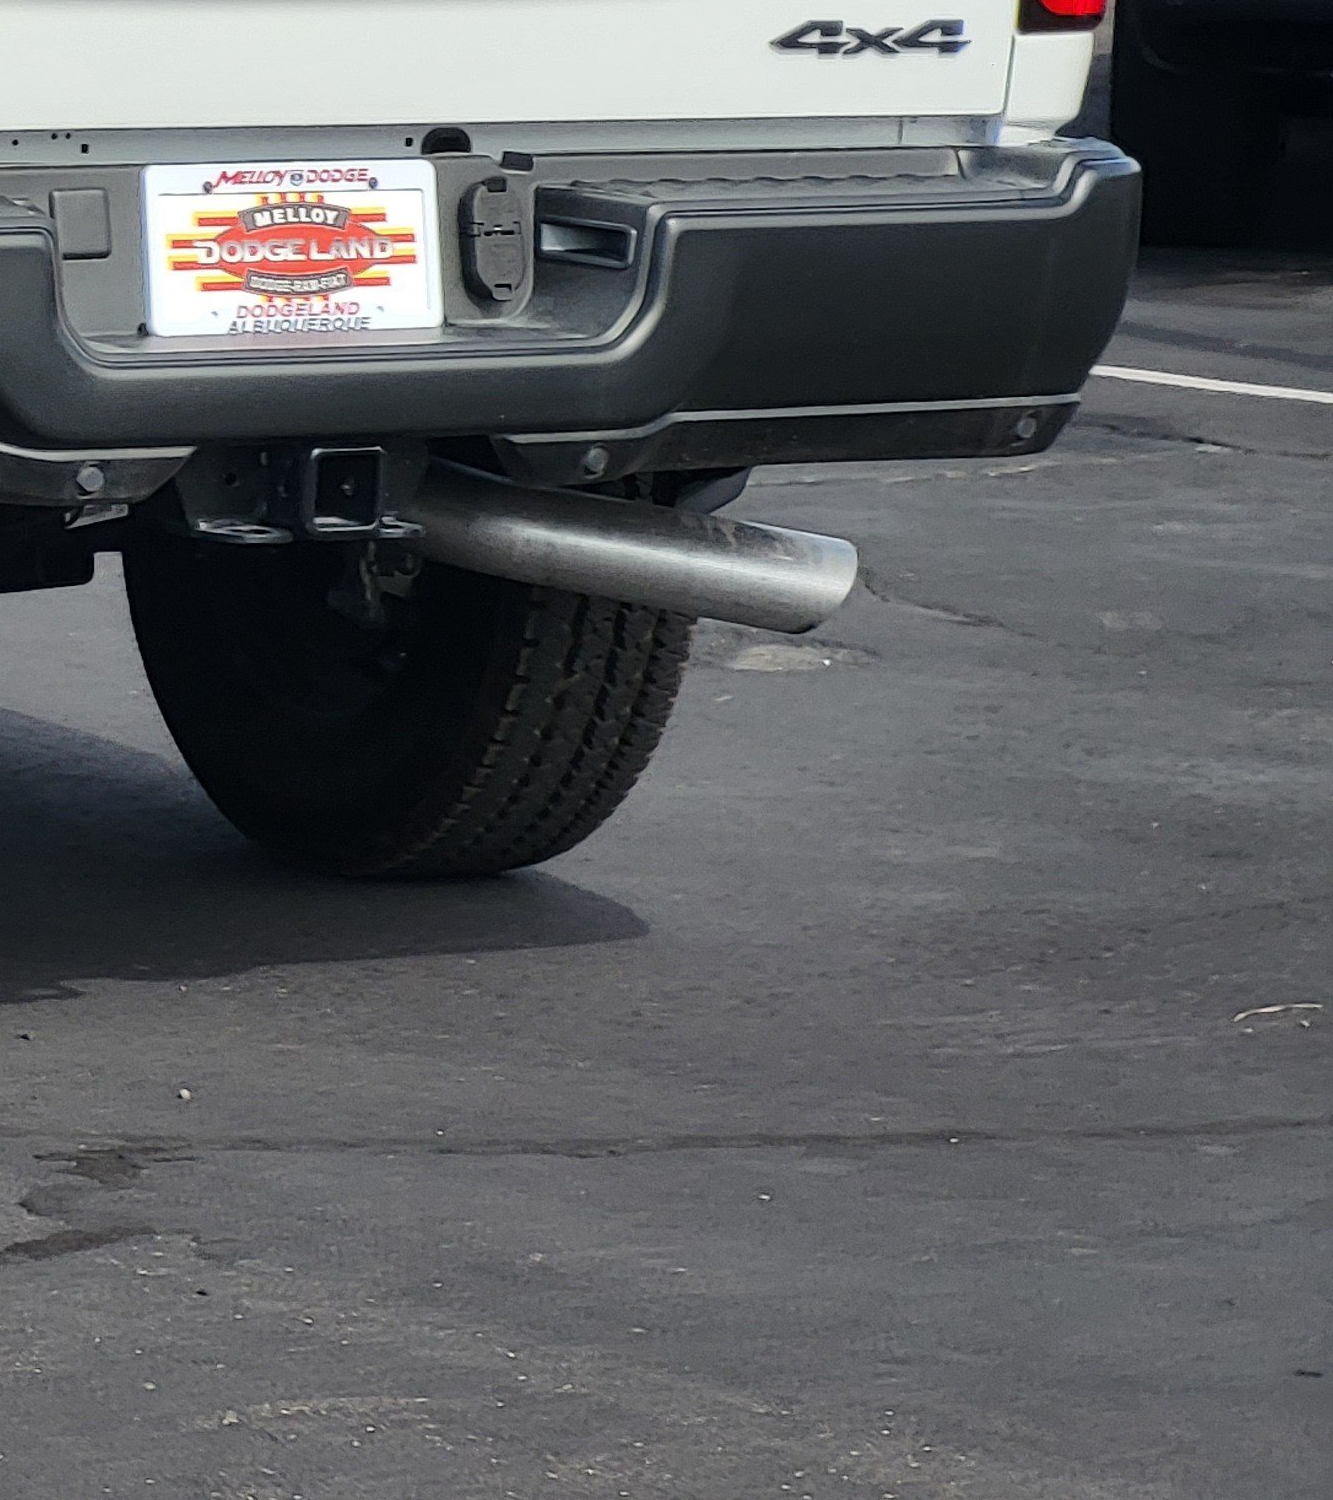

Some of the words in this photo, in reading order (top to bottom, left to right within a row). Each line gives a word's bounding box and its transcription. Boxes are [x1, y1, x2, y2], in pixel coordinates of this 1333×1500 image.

[769, 19, 972, 56] 4x4
[213, 169, 288, 188] MELLOY
[306, 168, 369, 184] DODGE
[253, 207, 340, 227] MELLOY
[236, 301, 360, 319] DODGELAND
[227, 316, 373, 336] ALBUQUERQUE
